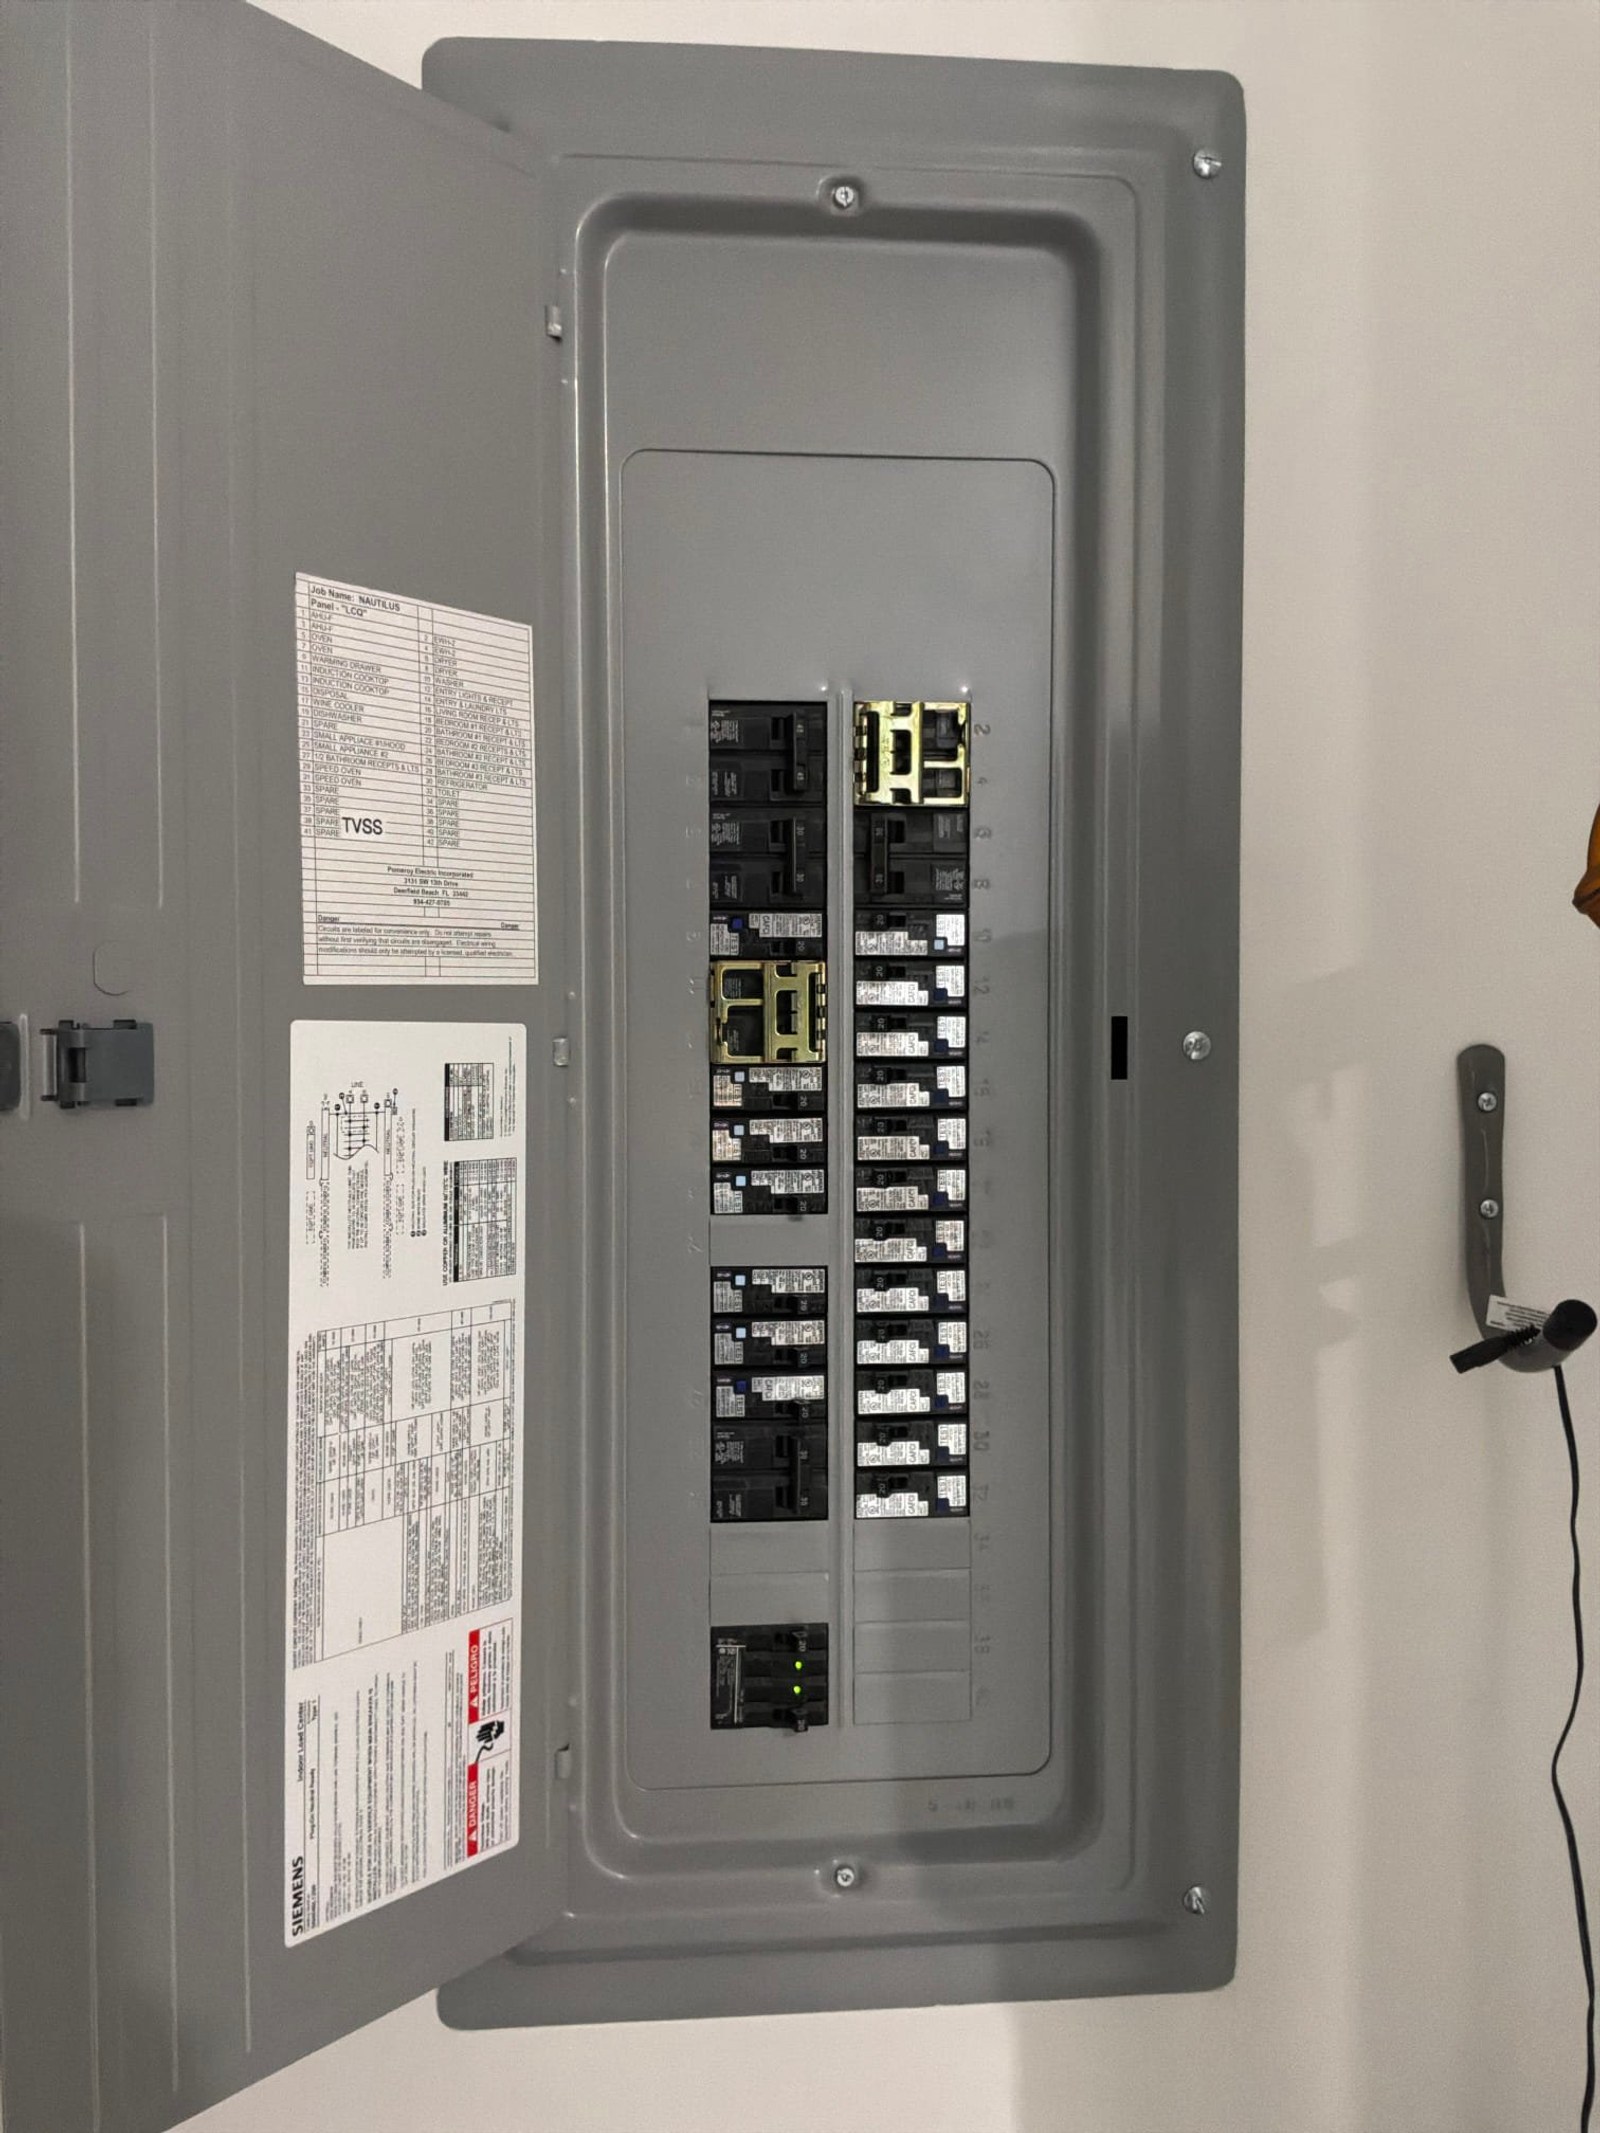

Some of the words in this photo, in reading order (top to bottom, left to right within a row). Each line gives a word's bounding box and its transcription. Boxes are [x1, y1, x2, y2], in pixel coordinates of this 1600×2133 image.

[311, 585, 326, 596] Job
[328, 589, 354, 602] Name:
[358, 595, 400, 612] NAUTILUS
[311, 599, 334, 610] Panel
[341, 816, 382, 835] TVSS
[415, 868, 436, 876] Electric
[292, 1856, 303, 1937] SIEMENS
